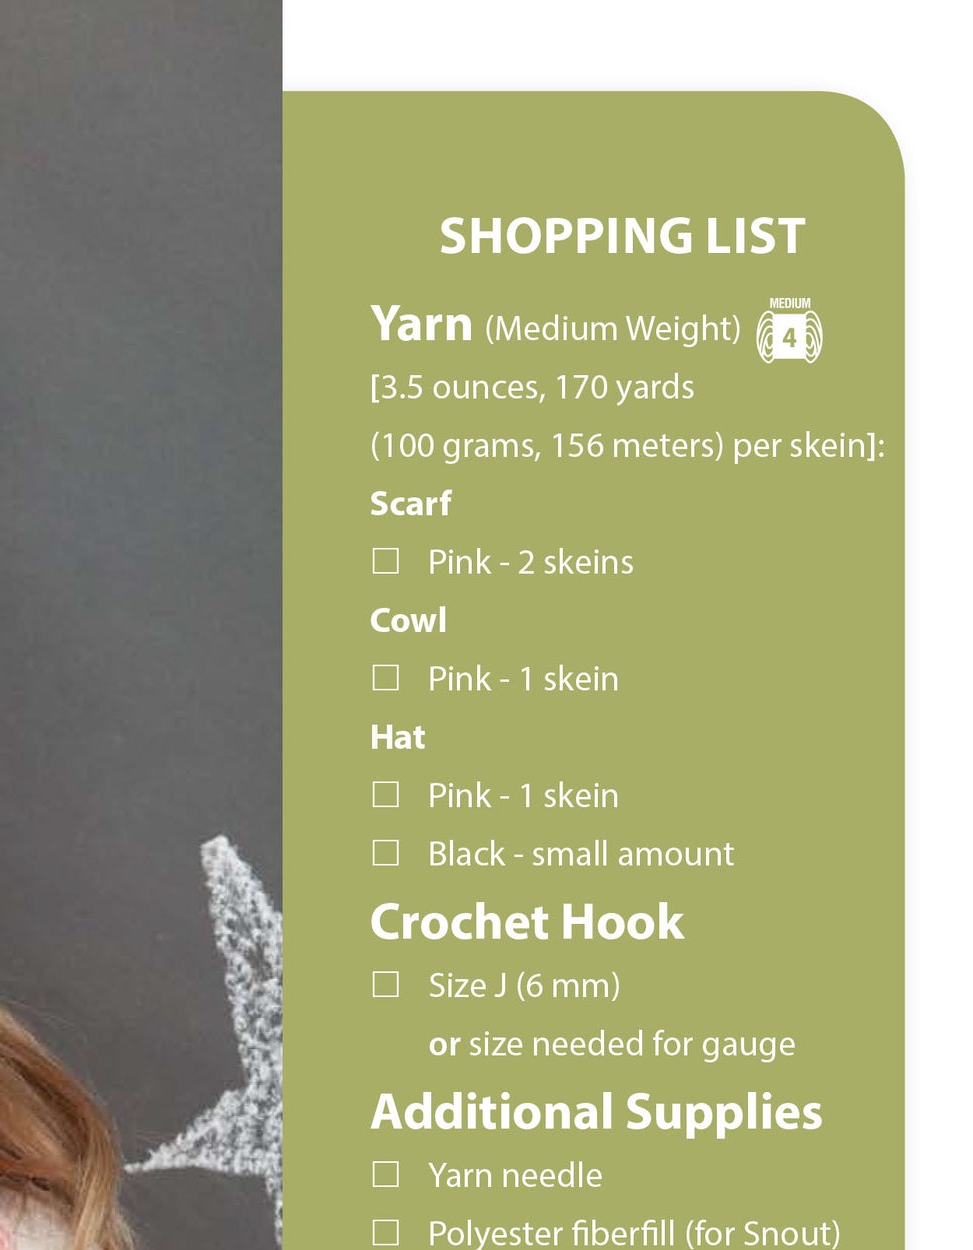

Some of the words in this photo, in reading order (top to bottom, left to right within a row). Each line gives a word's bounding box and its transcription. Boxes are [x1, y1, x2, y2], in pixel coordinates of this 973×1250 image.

[441, 217, 691, 255] SHOPPING
[708, 217, 806, 255] LIST
[769, 297, 811, 309] MEDIUM
[370, 305, 472, 342] Yarn
[486, 314, 618, 345] (Medium
[626, 314, 741, 348] Weight)
[782, 327, 797, 348] 4
[371, 373, 423, 404] [3.5
[433, 379, 546, 404] ounces,
[556, 374, 608, 400] 170
[616, 373, 695, 407] yards
[371, 432, 435, 462] (100
[443, 438, 541, 465] grams,
[552, 432, 605, 458] 156
[613, 431, 724, 462] meters)
[733, 438, 783, 465] per
[791, 431, 885, 462] skein]:
[370, 489, 453, 517] Scarf
[429, 547, 492, 575] Pink
[518, 549, 535, 575] 2
[544, 547, 634, 575] skeins
[370, 606, 447, 633] Cowl
[429, 664, 492, 692] Pink
[520, 666, 531, 692] 1
[544, 664, 619, 692] skein
[371, 723, 426, 750] Hat
[429, 781, 492, 809] Pink
[520, 783, 531, 808] 1
[544, 781, 619, 808] skein
[429, 839, 507, 867] Black
[532, 839, 608, 867] small
[618, 842, 735, 867] amount
[370, 902, 550, 941] Crochet
[563, 902, 686, 941] Hook
[429, 972, 487, 998] Size
[494, 973, 507, 998] J
[516, 971, 544, 1002] (6
[552, 971, 620, 1002] mm)
[429, 1036, 462, 1057] or
[469, 1030, 524, 1057] size
[533, 1029, 644, 1057] needed
[653, 1029, 694, 1057] for
[702, 1036, 796, 1064] gauge
[370, 1092, 613, 1131] Additional
[626, 1092, 823, 1140] Supplies
[428, 1161, 492, 1188] Yarn
[502, 1161, 603, 1188] needle
[572, 1219, 675, 1247] fiberfill
[685, 1219, 736, 1250] (for
[744, 1219, 840, 1250] Snout)
